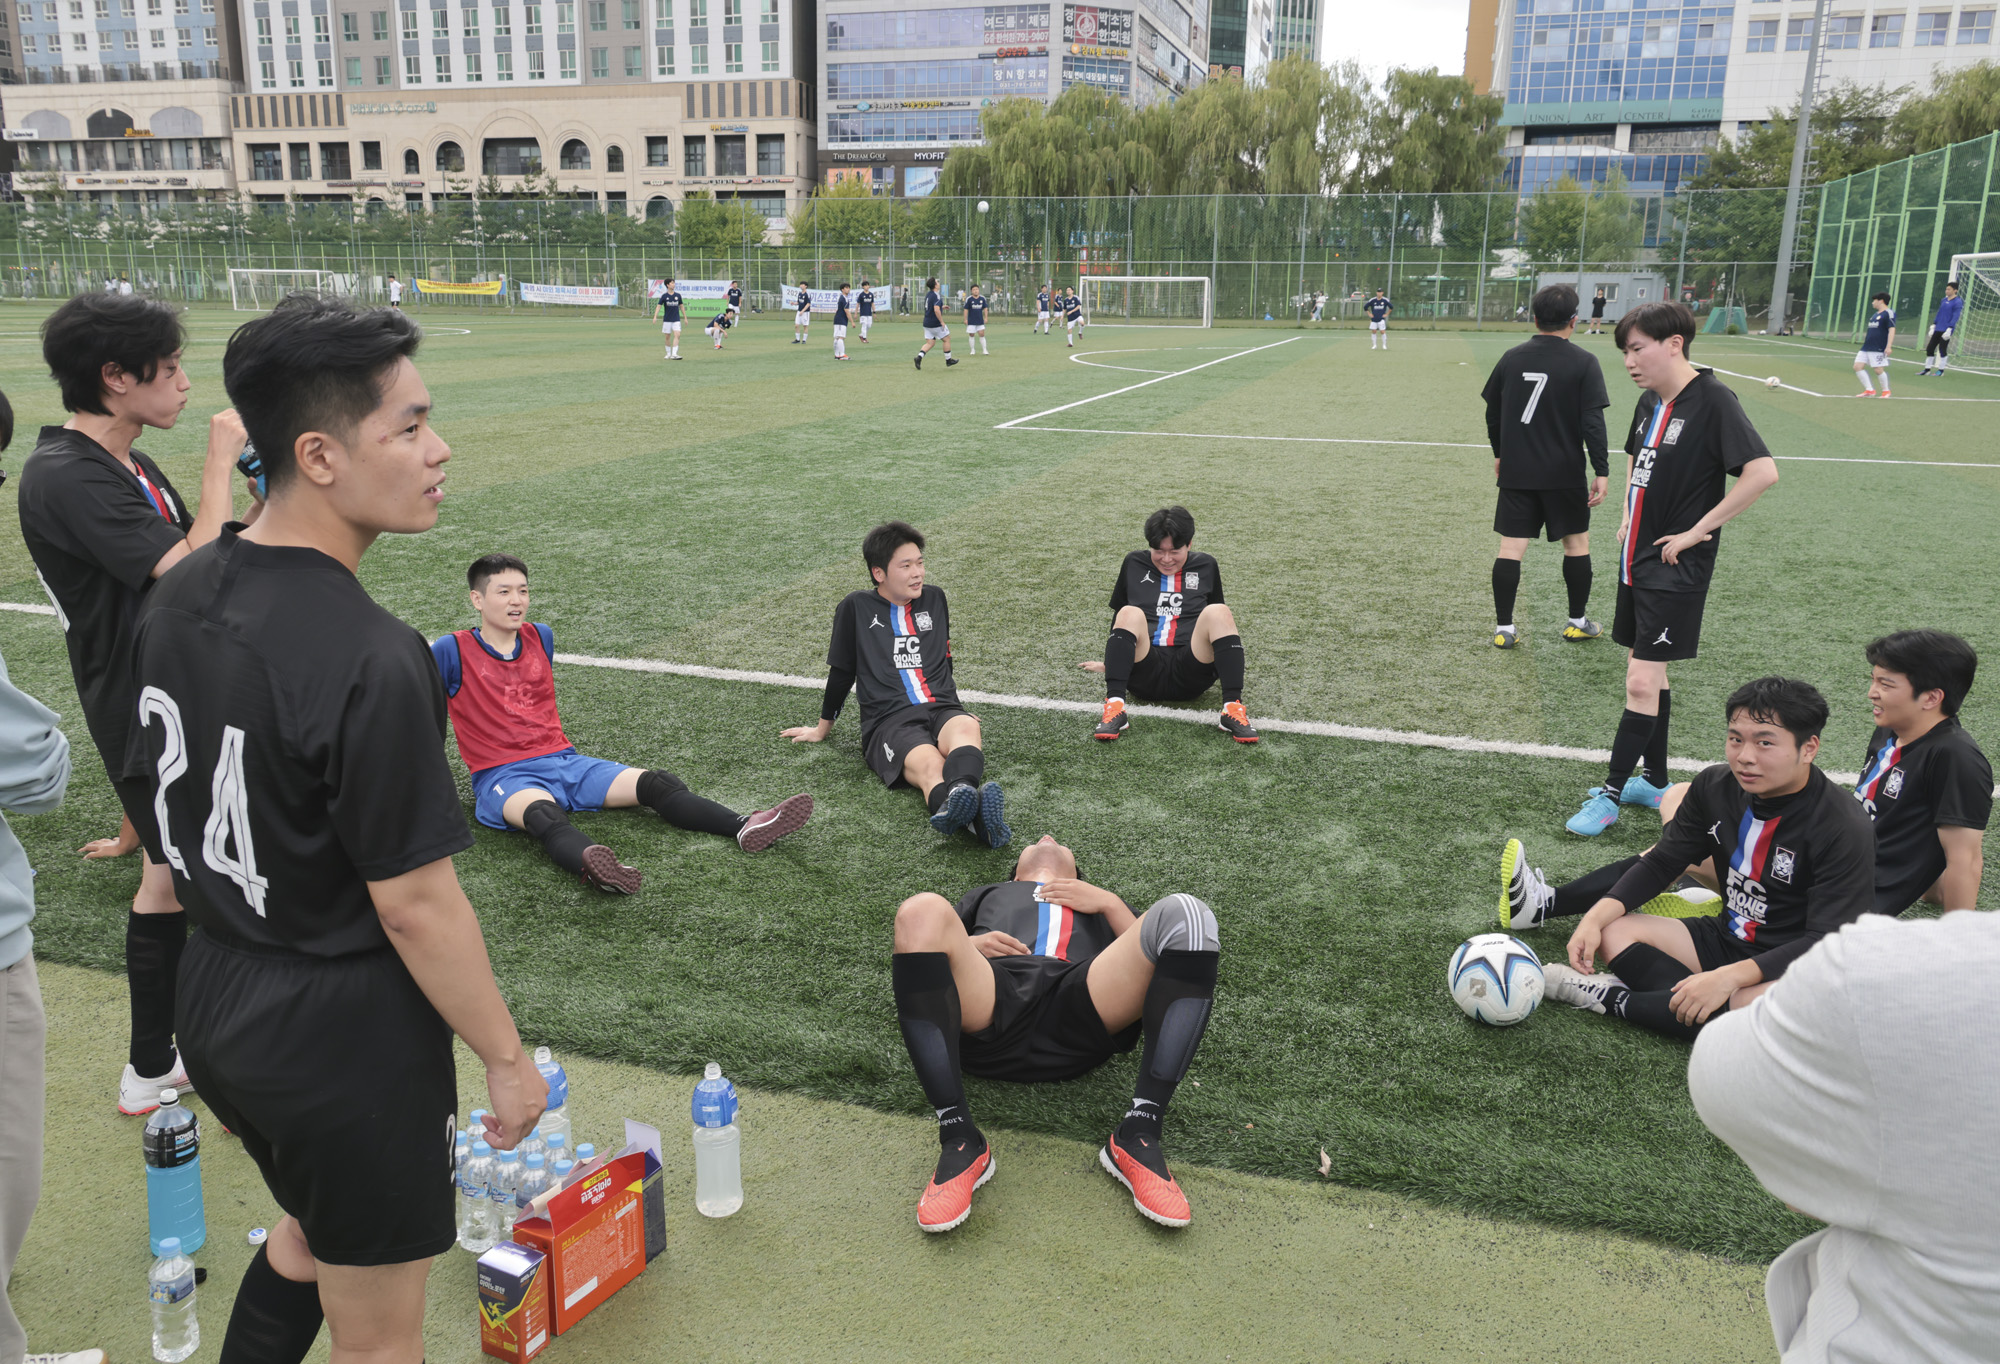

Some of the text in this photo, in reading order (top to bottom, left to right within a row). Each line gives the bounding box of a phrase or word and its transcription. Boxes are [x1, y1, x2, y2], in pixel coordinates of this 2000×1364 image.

[985, 13, 1049, 29] 여드름 체질
[1099, 29, 1131, 45] 한의원
[1529, 111, 1664, 122] UNION ART CENTER
[914, 152, 945, 161] MYOFIT
[1521, 372, 1549, 425] 7
[1635, 447, 1657, 469] FC
[1157, 592, 1183, 607] FC
[893, 636, 920, 654] FC
[893, 653, 923, 669] 일요신문
[884, 742, 895, 762] 4
[138, 685, 270, 918] 24
[1726, 866, 1767, 902] FC
[1726, 886, 1768, 925] 일요신문
